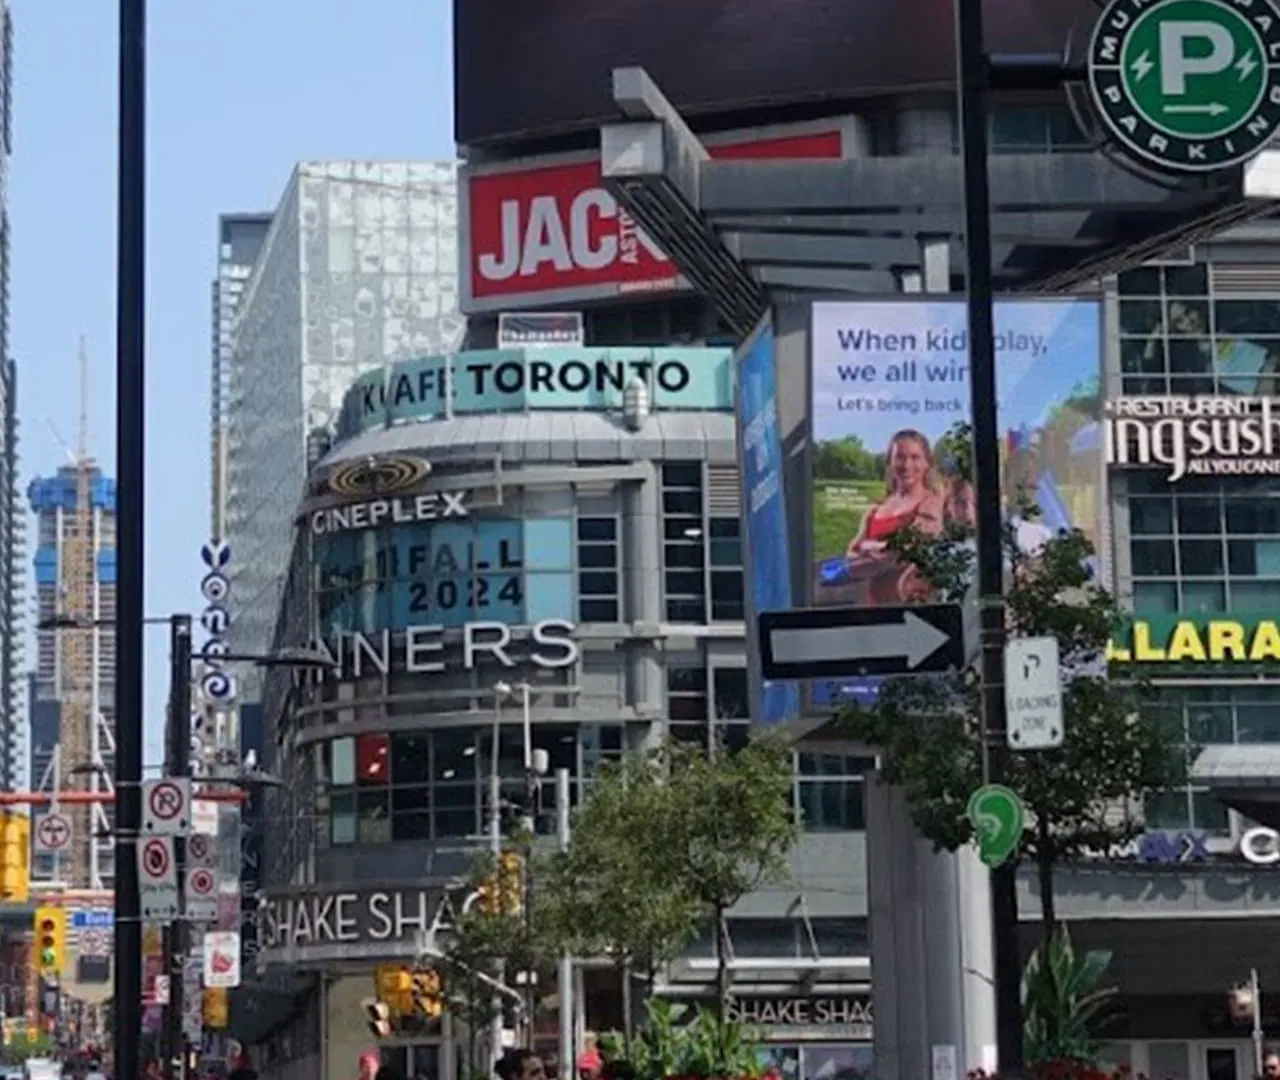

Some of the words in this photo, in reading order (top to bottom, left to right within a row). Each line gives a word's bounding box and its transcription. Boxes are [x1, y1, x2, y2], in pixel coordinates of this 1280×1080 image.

[1158, 20, 1236, 96] P
[479, 187, 668, 281] JAC
[837, 328, 917, 353] When
[925, 327, 968, 353] kid
[466, 359, 692, 397] TORONTO
[837, 364, 877, 383] we
[886, 360, 917, 383] all
[837, 397, 874, 413] Let's
[877, 397, 919, 415] bring
[924, 397, 963, 413] back
[1105, 401, 1186, 482] ing
[312, 490, 468, 535] CINEPLEX
[408, 539, 524, 574] FALL
[409, 576, 524, 613] 2024
[317, 619, 577, 682] NNERS
